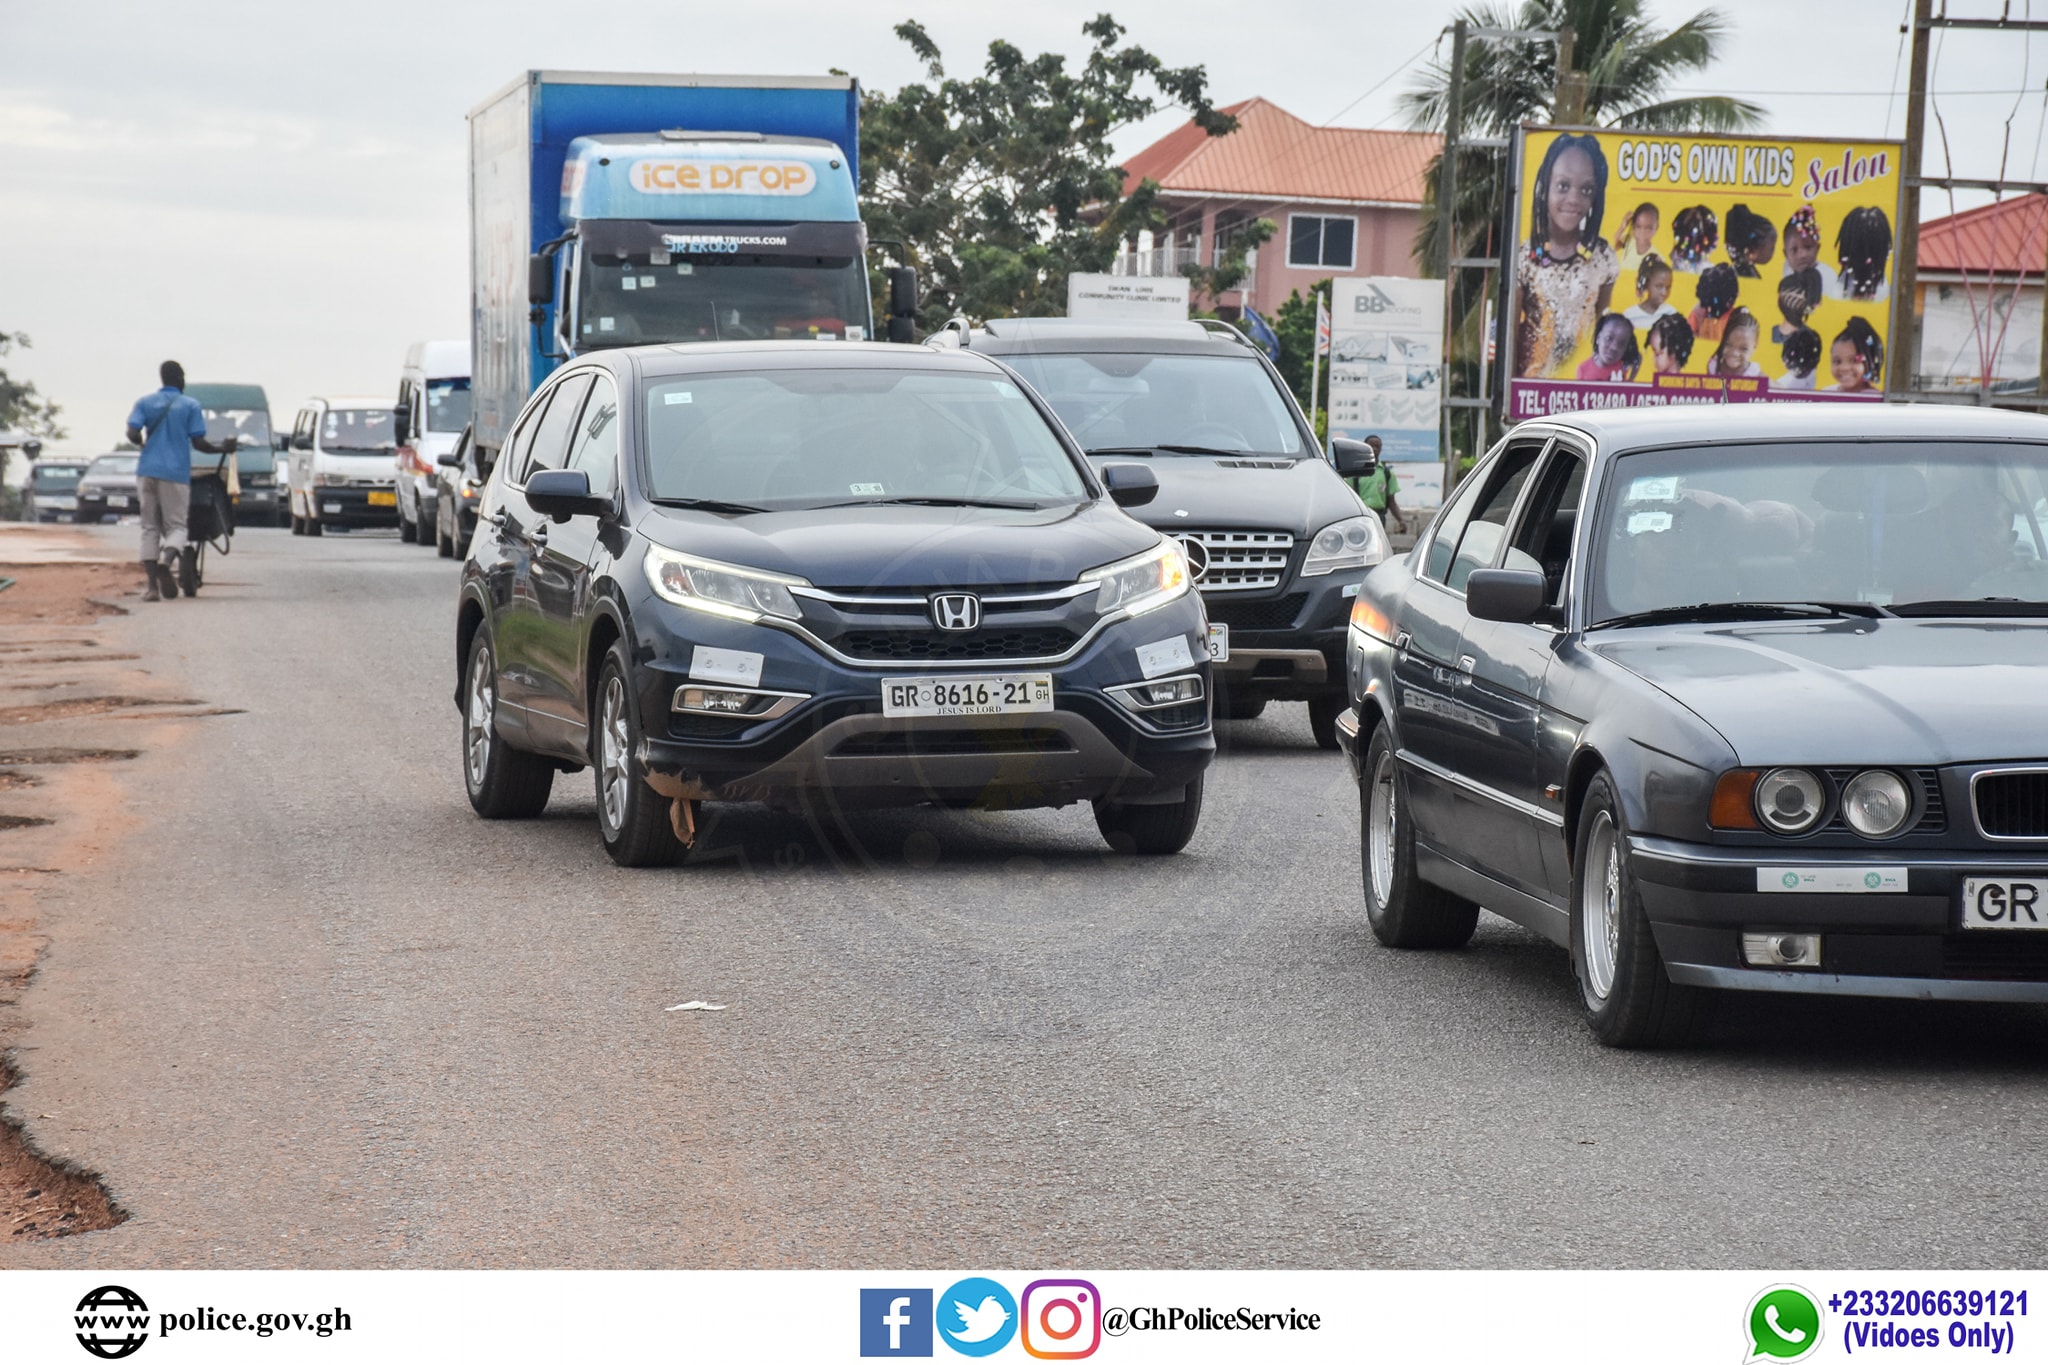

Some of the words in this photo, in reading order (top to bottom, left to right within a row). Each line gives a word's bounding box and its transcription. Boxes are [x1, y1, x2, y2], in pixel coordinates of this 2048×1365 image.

[1618, 141, 1682, 183] GOD'S
[1688, 145, 1742, 185] OWN
[1743, 146, 1794, 187] KIDS
[1802, 147, 1890, 199] Salon
[1518, 389, 1545, 415] TEL:
[891, 685, 918, 707] GR
[934, 682, 1031, 706] 8616-21
[1036, 690, 1049, 701] GH
[937, 706, 964, 715] JESUS
[966, 706, 975, 714] IS
[977, 705, 1002, 714] LORD
[1977, 883, 2039, 922] GR
